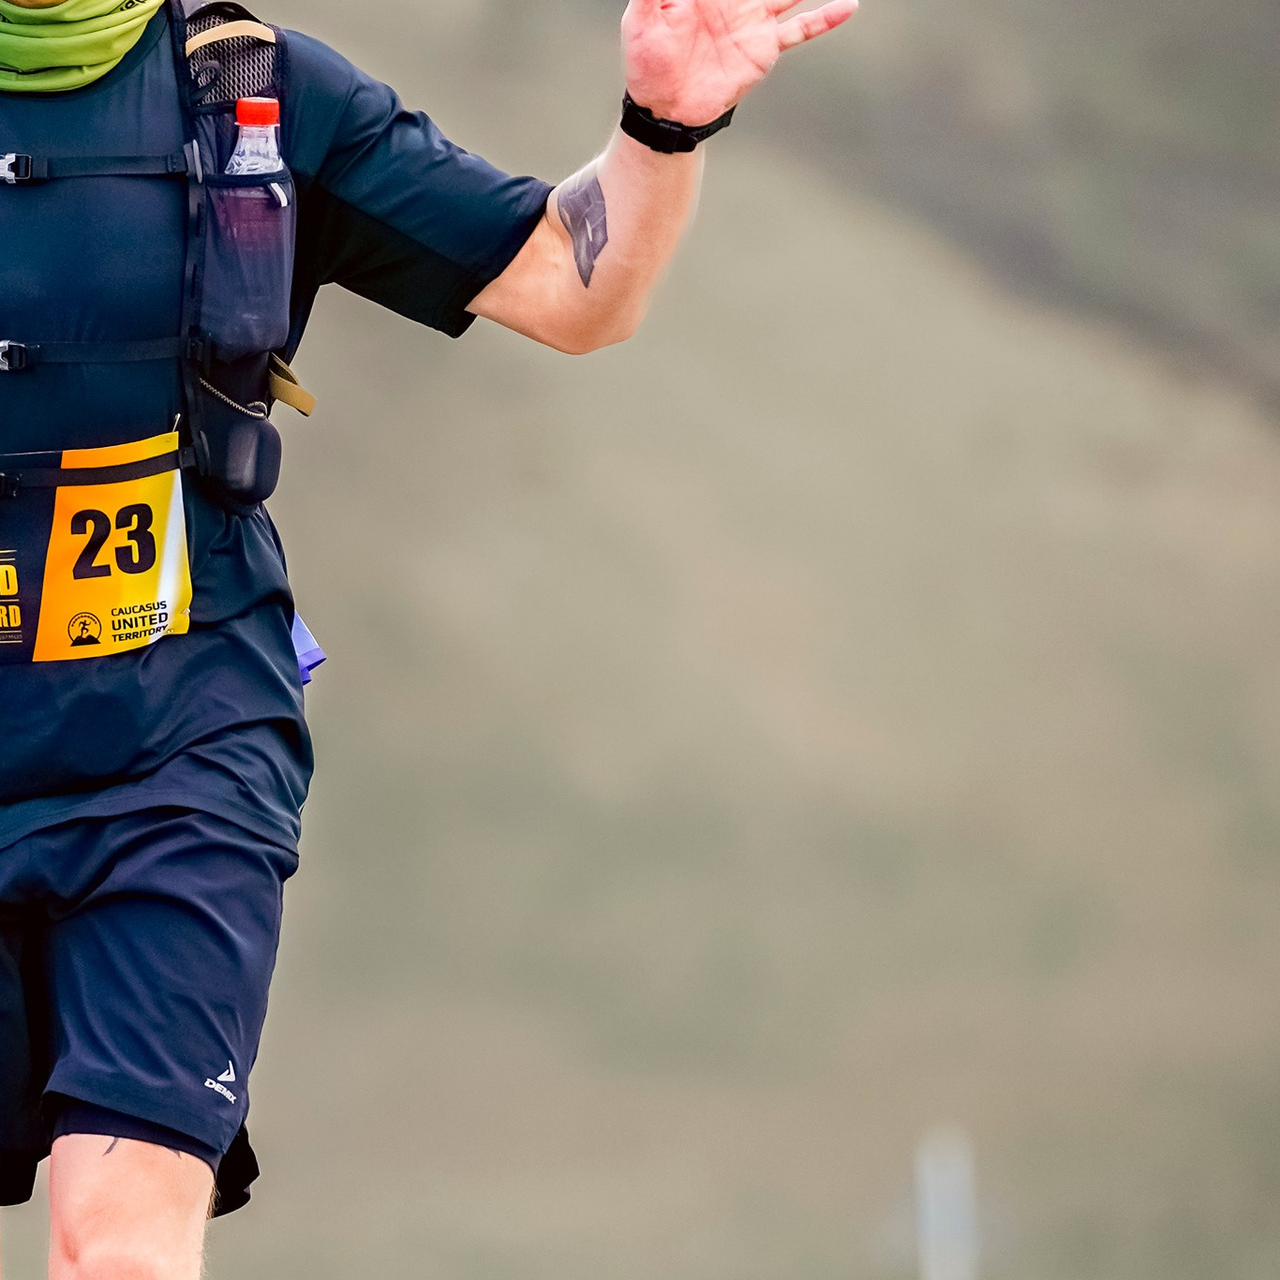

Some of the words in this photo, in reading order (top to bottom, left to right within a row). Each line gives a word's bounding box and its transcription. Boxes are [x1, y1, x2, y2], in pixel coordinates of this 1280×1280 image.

[70, 503, 157, 580] 23
[111, 600, 167, 617] CAUCASUS
[112, 612, 168, 631] UNITED
[111, 624, 169, 642] TERRITORY
[204, 1077, 237, 1104] DEMIX
